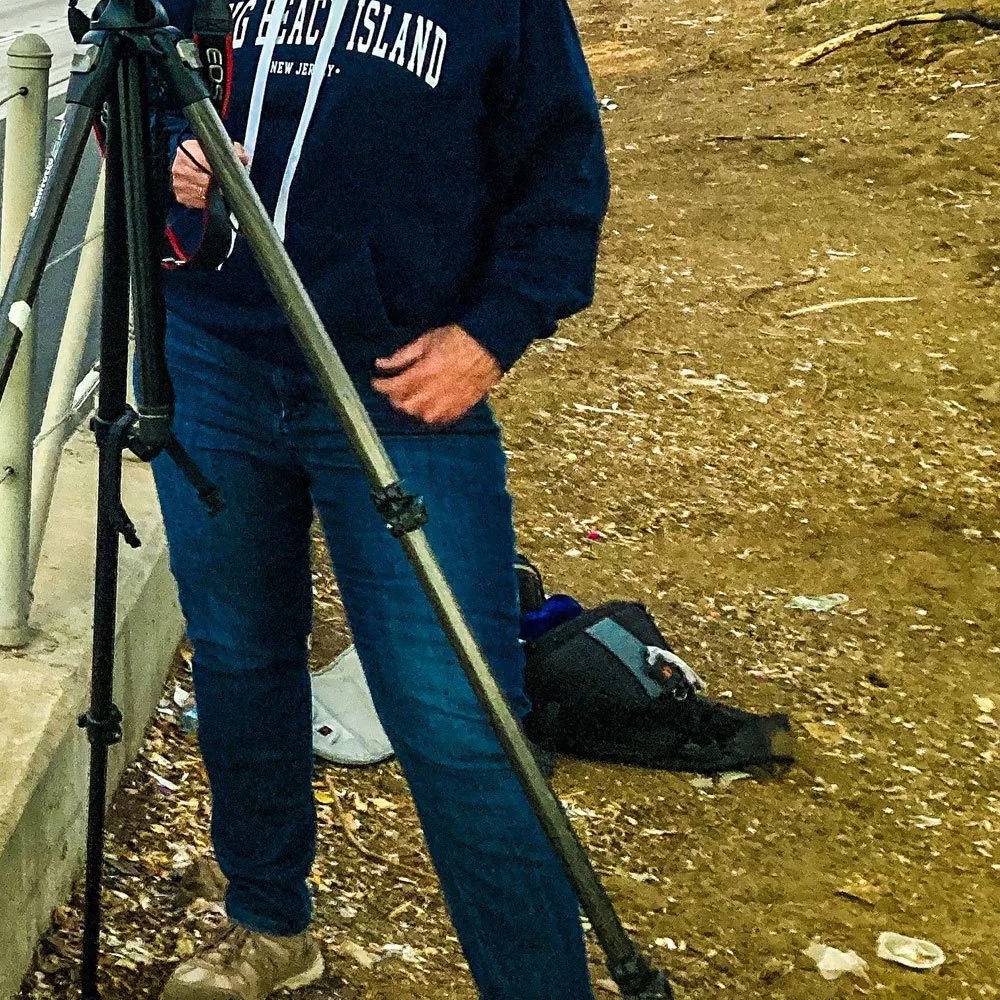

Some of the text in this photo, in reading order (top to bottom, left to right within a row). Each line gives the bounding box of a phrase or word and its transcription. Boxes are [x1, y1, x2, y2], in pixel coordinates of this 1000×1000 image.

[206, 47, 224, 101] EOS
[269, 60, 335, 77] NEW JERY
